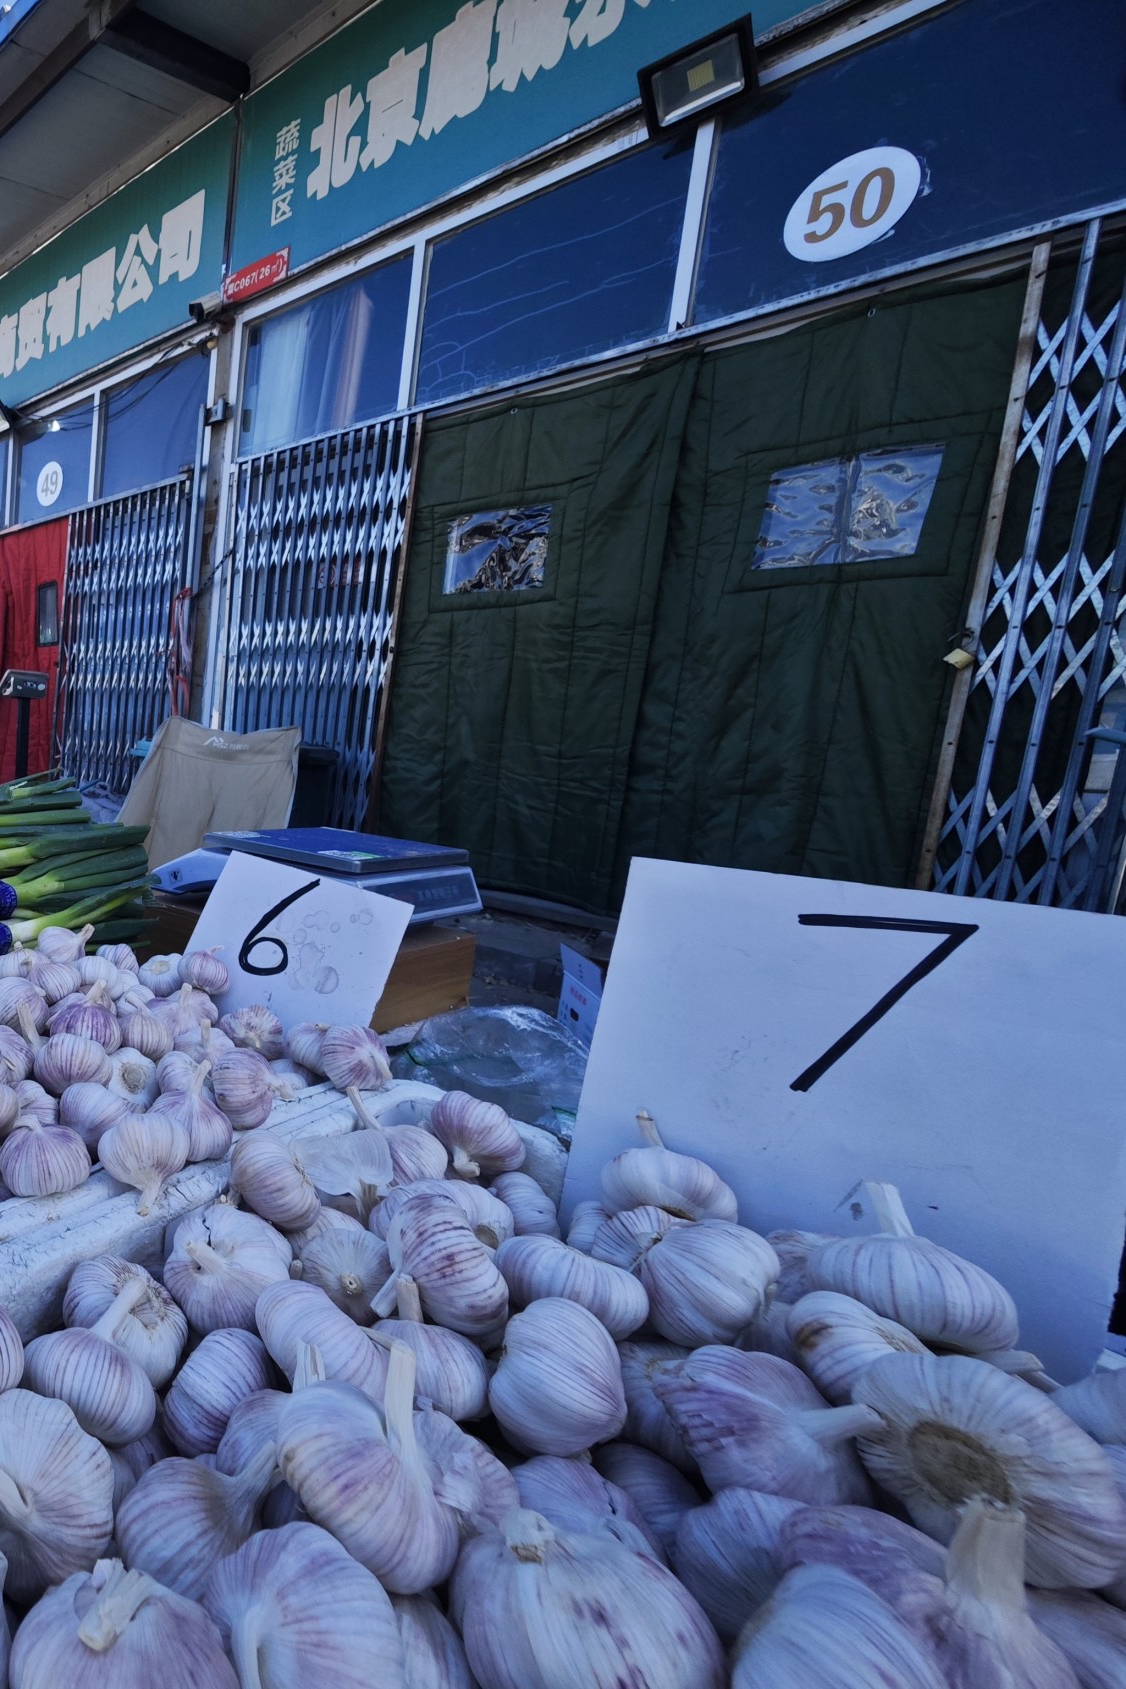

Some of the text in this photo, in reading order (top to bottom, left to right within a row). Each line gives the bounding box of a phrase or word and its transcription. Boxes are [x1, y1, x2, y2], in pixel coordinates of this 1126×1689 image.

[271, 118, 301, 227] 蔬菜区
[803, 166, 896, 245] 50
[41, 470, 59, 497] 49
[238, 878, 322, 976] 6
[790, 913, 980, 1094] 7
